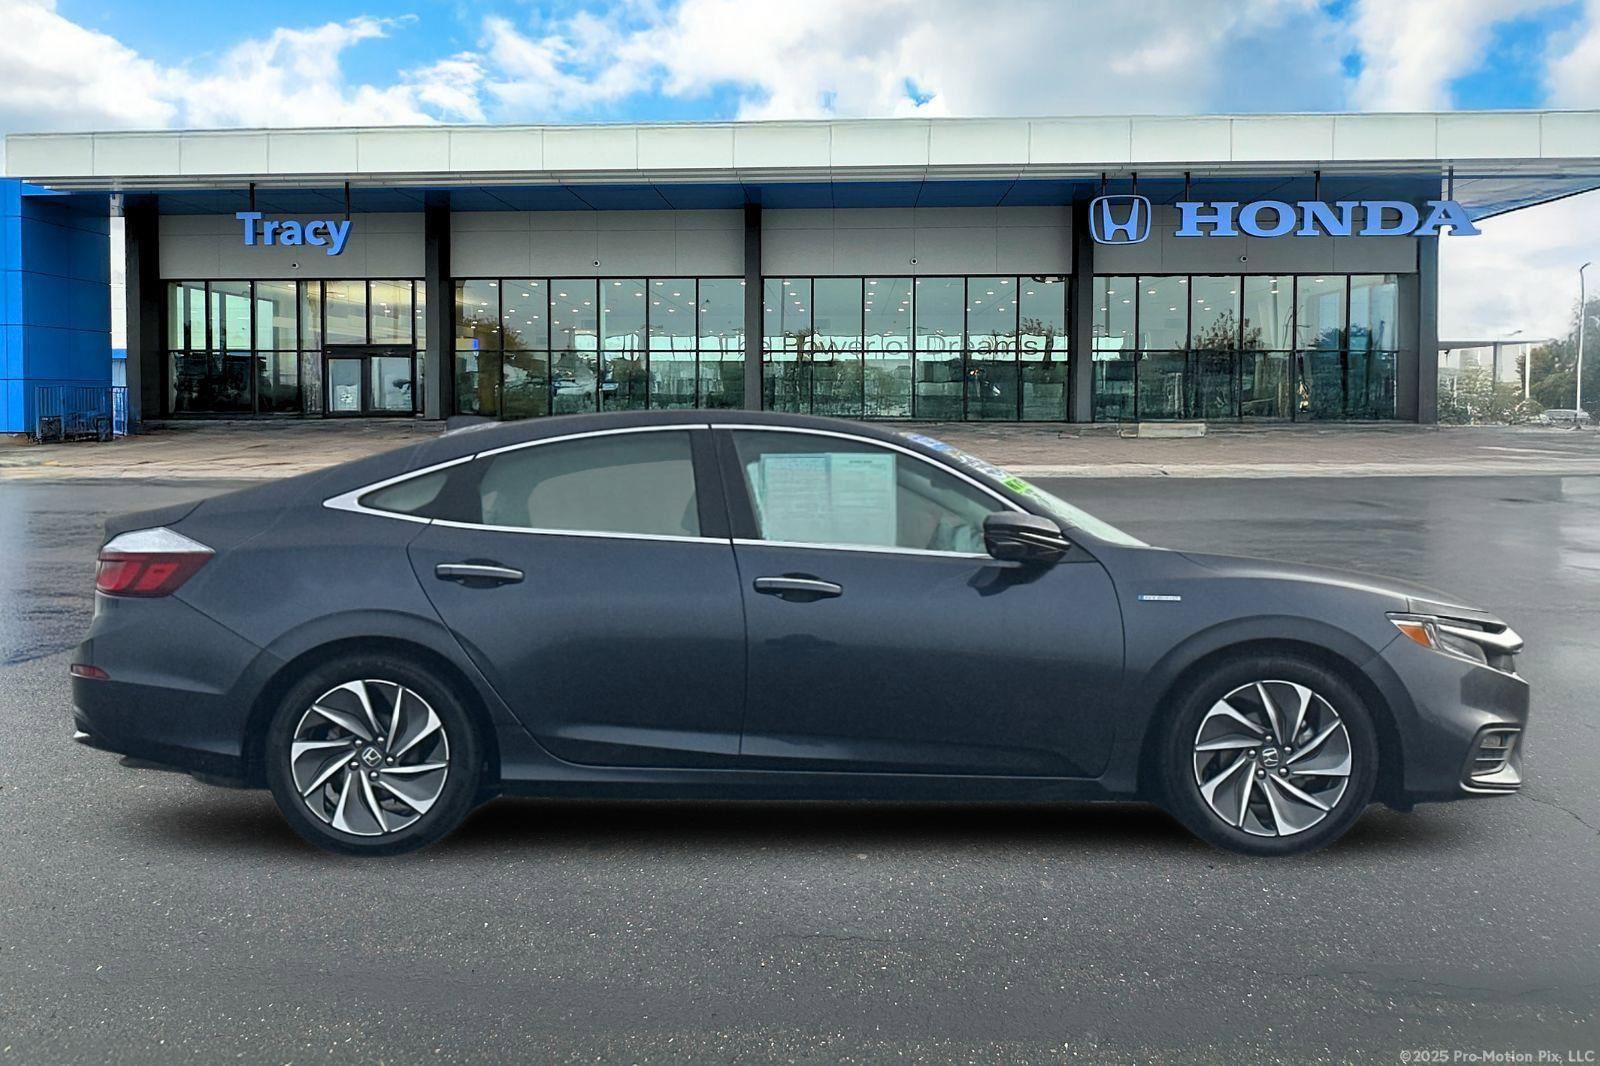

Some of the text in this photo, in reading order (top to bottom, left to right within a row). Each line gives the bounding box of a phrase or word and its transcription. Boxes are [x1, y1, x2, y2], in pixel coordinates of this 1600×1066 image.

[236, 211, 351, 256] Tracy
[1175, 200, 1482, 238] HONDA
[783, 335, 875, 355] Power
[926, 335, 1038, 355] Dreams
